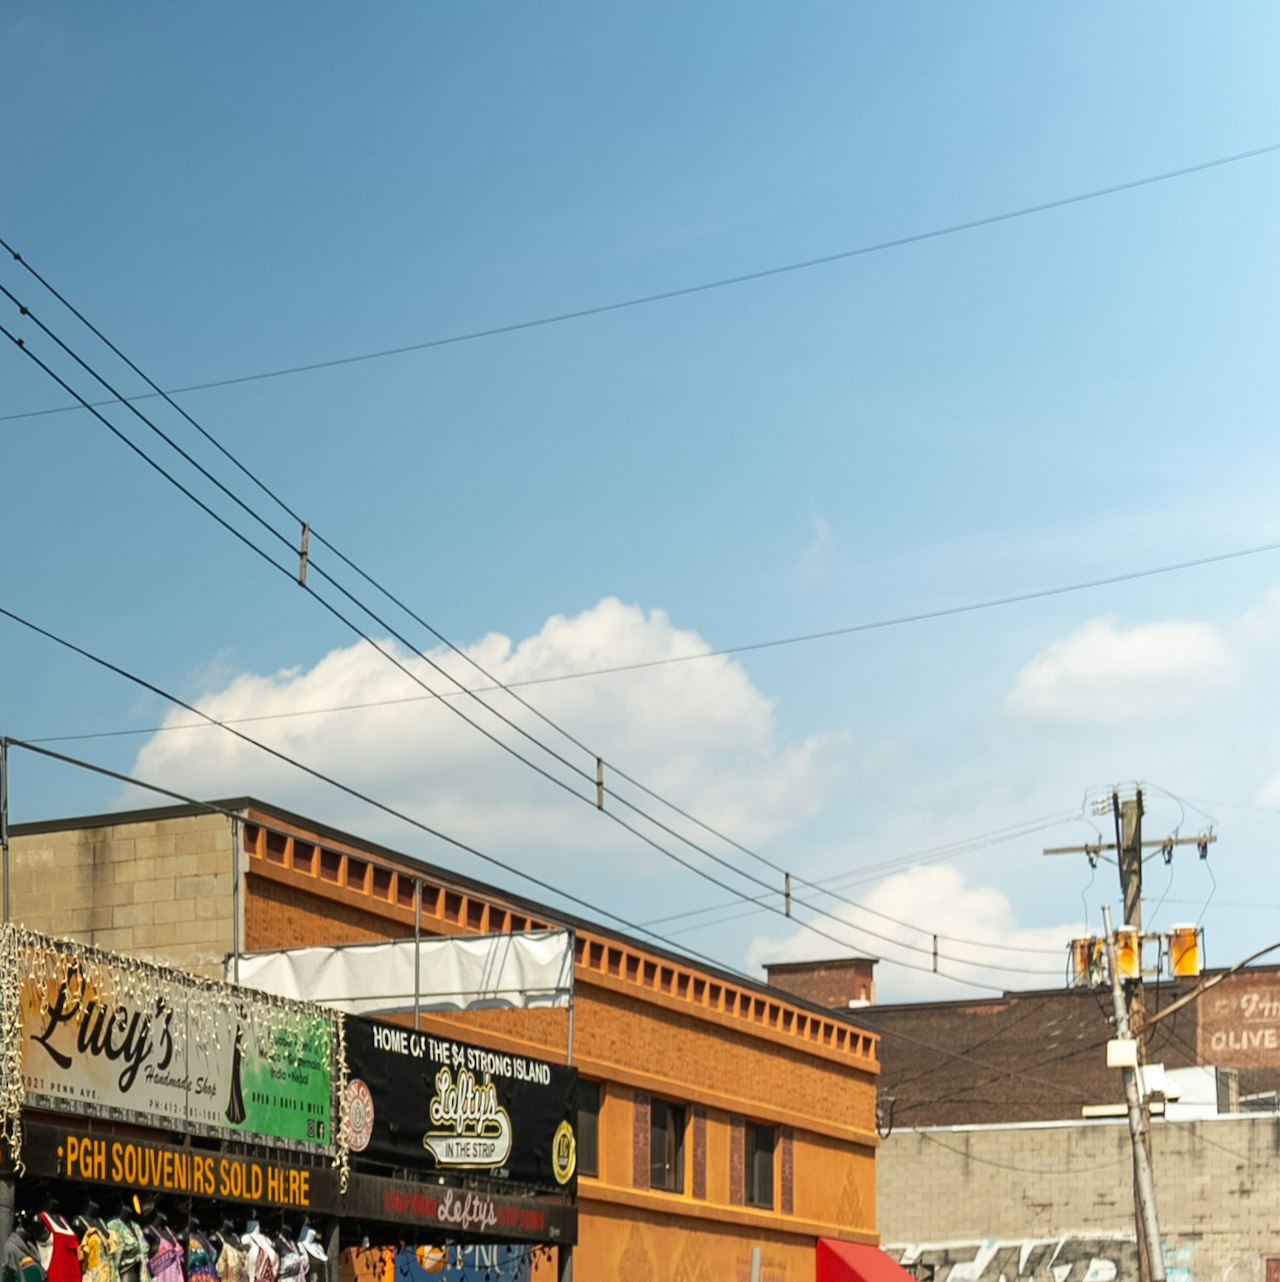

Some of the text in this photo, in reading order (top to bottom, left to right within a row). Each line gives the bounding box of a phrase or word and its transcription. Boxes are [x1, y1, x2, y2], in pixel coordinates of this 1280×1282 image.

[30, 960, 174, 1093] Lucy's
[1211, 1029, 1278, 1051] OLIVE
[373, 1026, 409, 1054] HOME
[428, 1038, 451, 1064] THE
[451, 1041, 465, 1069] $4
[467, 1049, 512, 1078] STRONG
[513, 1059, 551, 1085] ISLAND
[50, 1082, 74, 1094] PENN
[80, 1087, 100, 1100] AVE.
[144, 1064, 217, 1100] Handmade Shop
[430, 1068, 498, 1135] Lefty's
[66, 1136, 310, 1206] PGH SOUVENIRS SOLD HERE
[445, 1142, 496, 1158] IN THE STRIP
[437, 1189, 496, 1231] Lefty's
